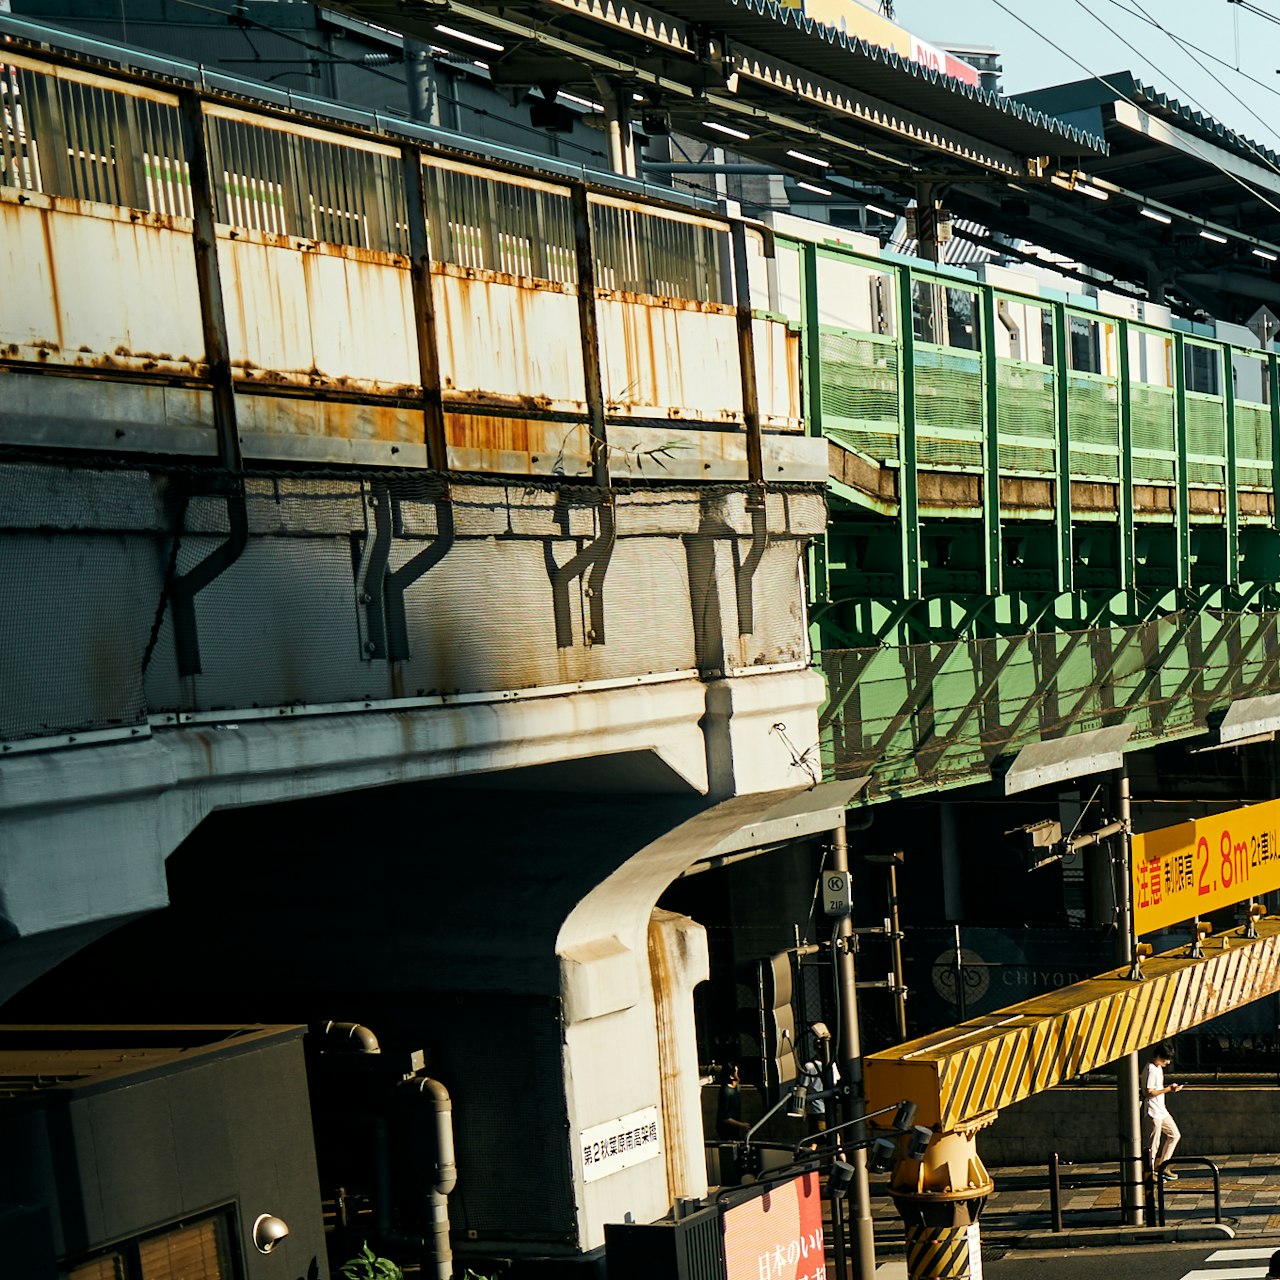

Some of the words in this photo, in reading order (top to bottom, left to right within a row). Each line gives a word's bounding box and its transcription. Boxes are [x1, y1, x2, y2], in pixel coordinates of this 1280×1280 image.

[1136, 855, 1162, 909] 注意
[1164, 853, 1194, 896] 制限高
[1197, 830, 1250, 897] 2.8m
[1002, 971, 1092, 988] CHIYOD
[583, 1121, 658, 1166] 第2秋葉原南高架橋
